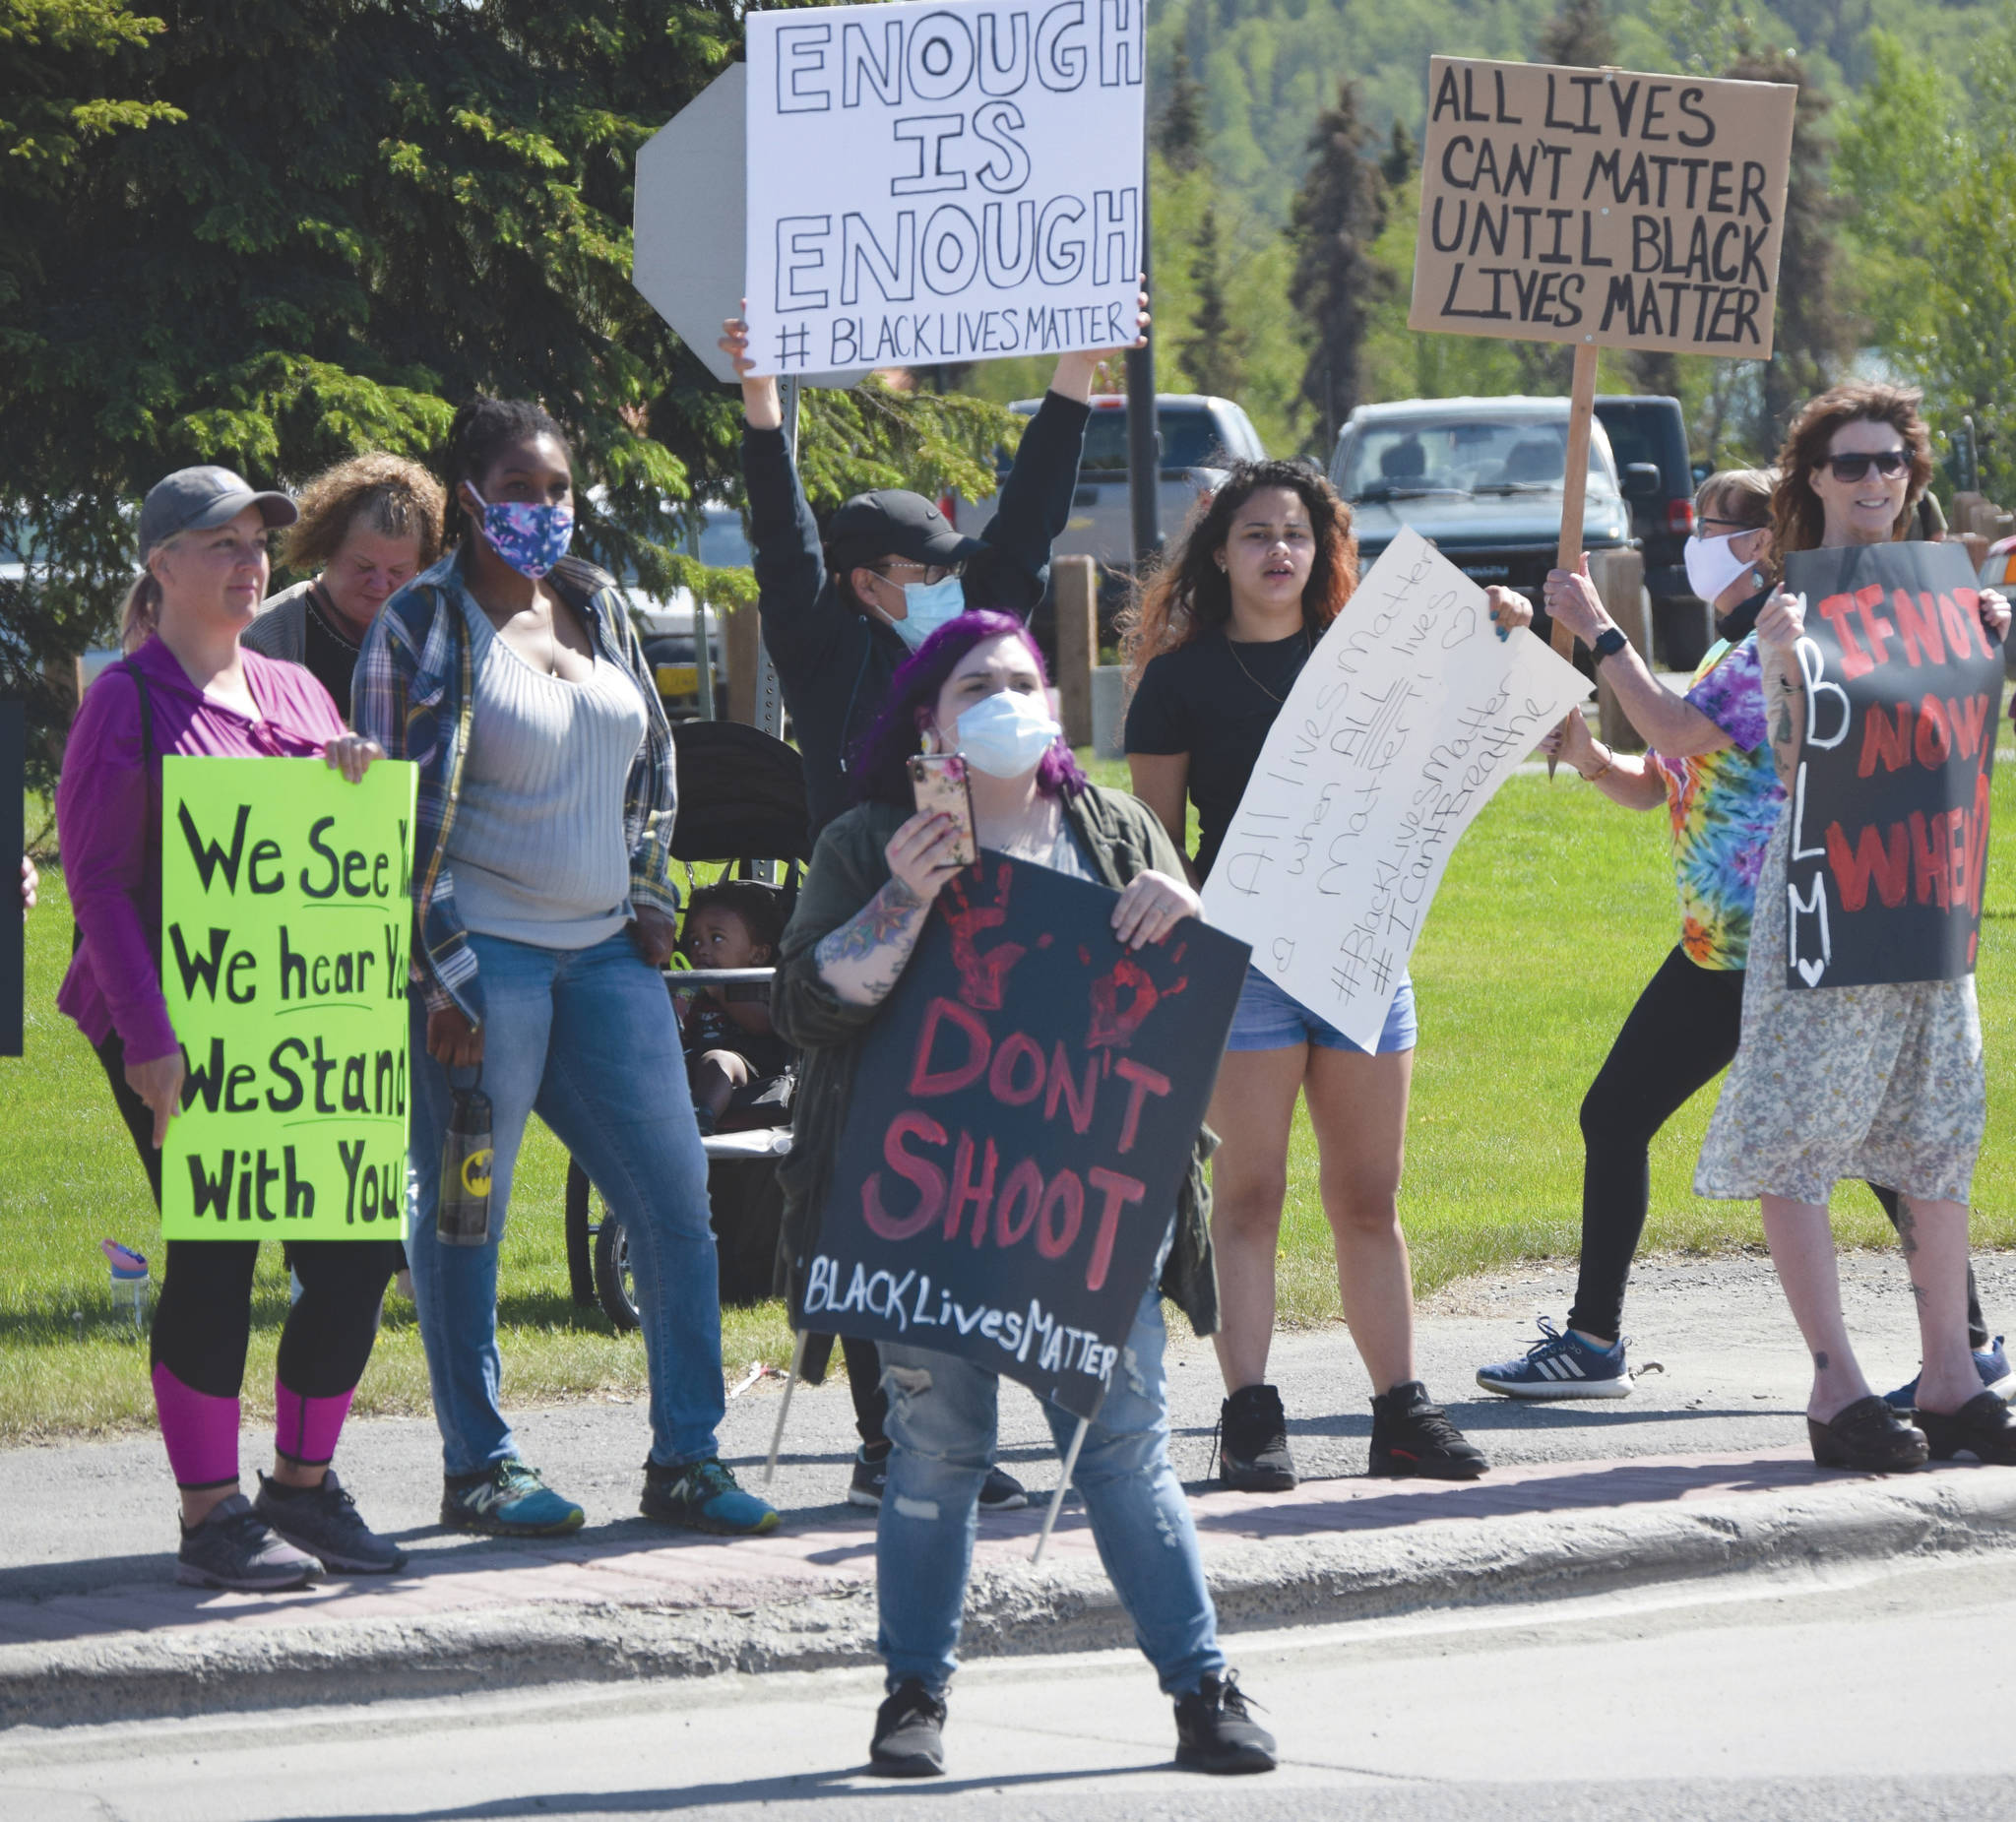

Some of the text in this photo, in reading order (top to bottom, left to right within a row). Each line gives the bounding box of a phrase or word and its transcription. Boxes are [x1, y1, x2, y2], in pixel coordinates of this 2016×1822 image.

[776, 0, 1143, 113] ENOUGH
[1432, 65, 1716, 148] ALL LIVES
[891, 99, 1031, 196] IS
[1441, 134, 1772, 224] CAN'T MATTER
[775, 187, 1138, 313] ENOUGH
[1431, 197, 1769, 293] UNTIL BLACK
[1440, 263, 1761, 345] LIVES MATTER
[1286, 590, 1458, 875] when ALL lives
[1227, 811, 1290, 895] All
[1267, 681, 1350, 785] lives
[177, 797, 284, 897] We
[299, 815, 390, 900] See
[168, 922, 257, 1005] We
[278, 923, 376, 1001] hear
[907, 994, 1172, 1155] DON'T
[186, 1139, 400, 1226] With You
[859, 1108, 1148, 1292] SHOOT
